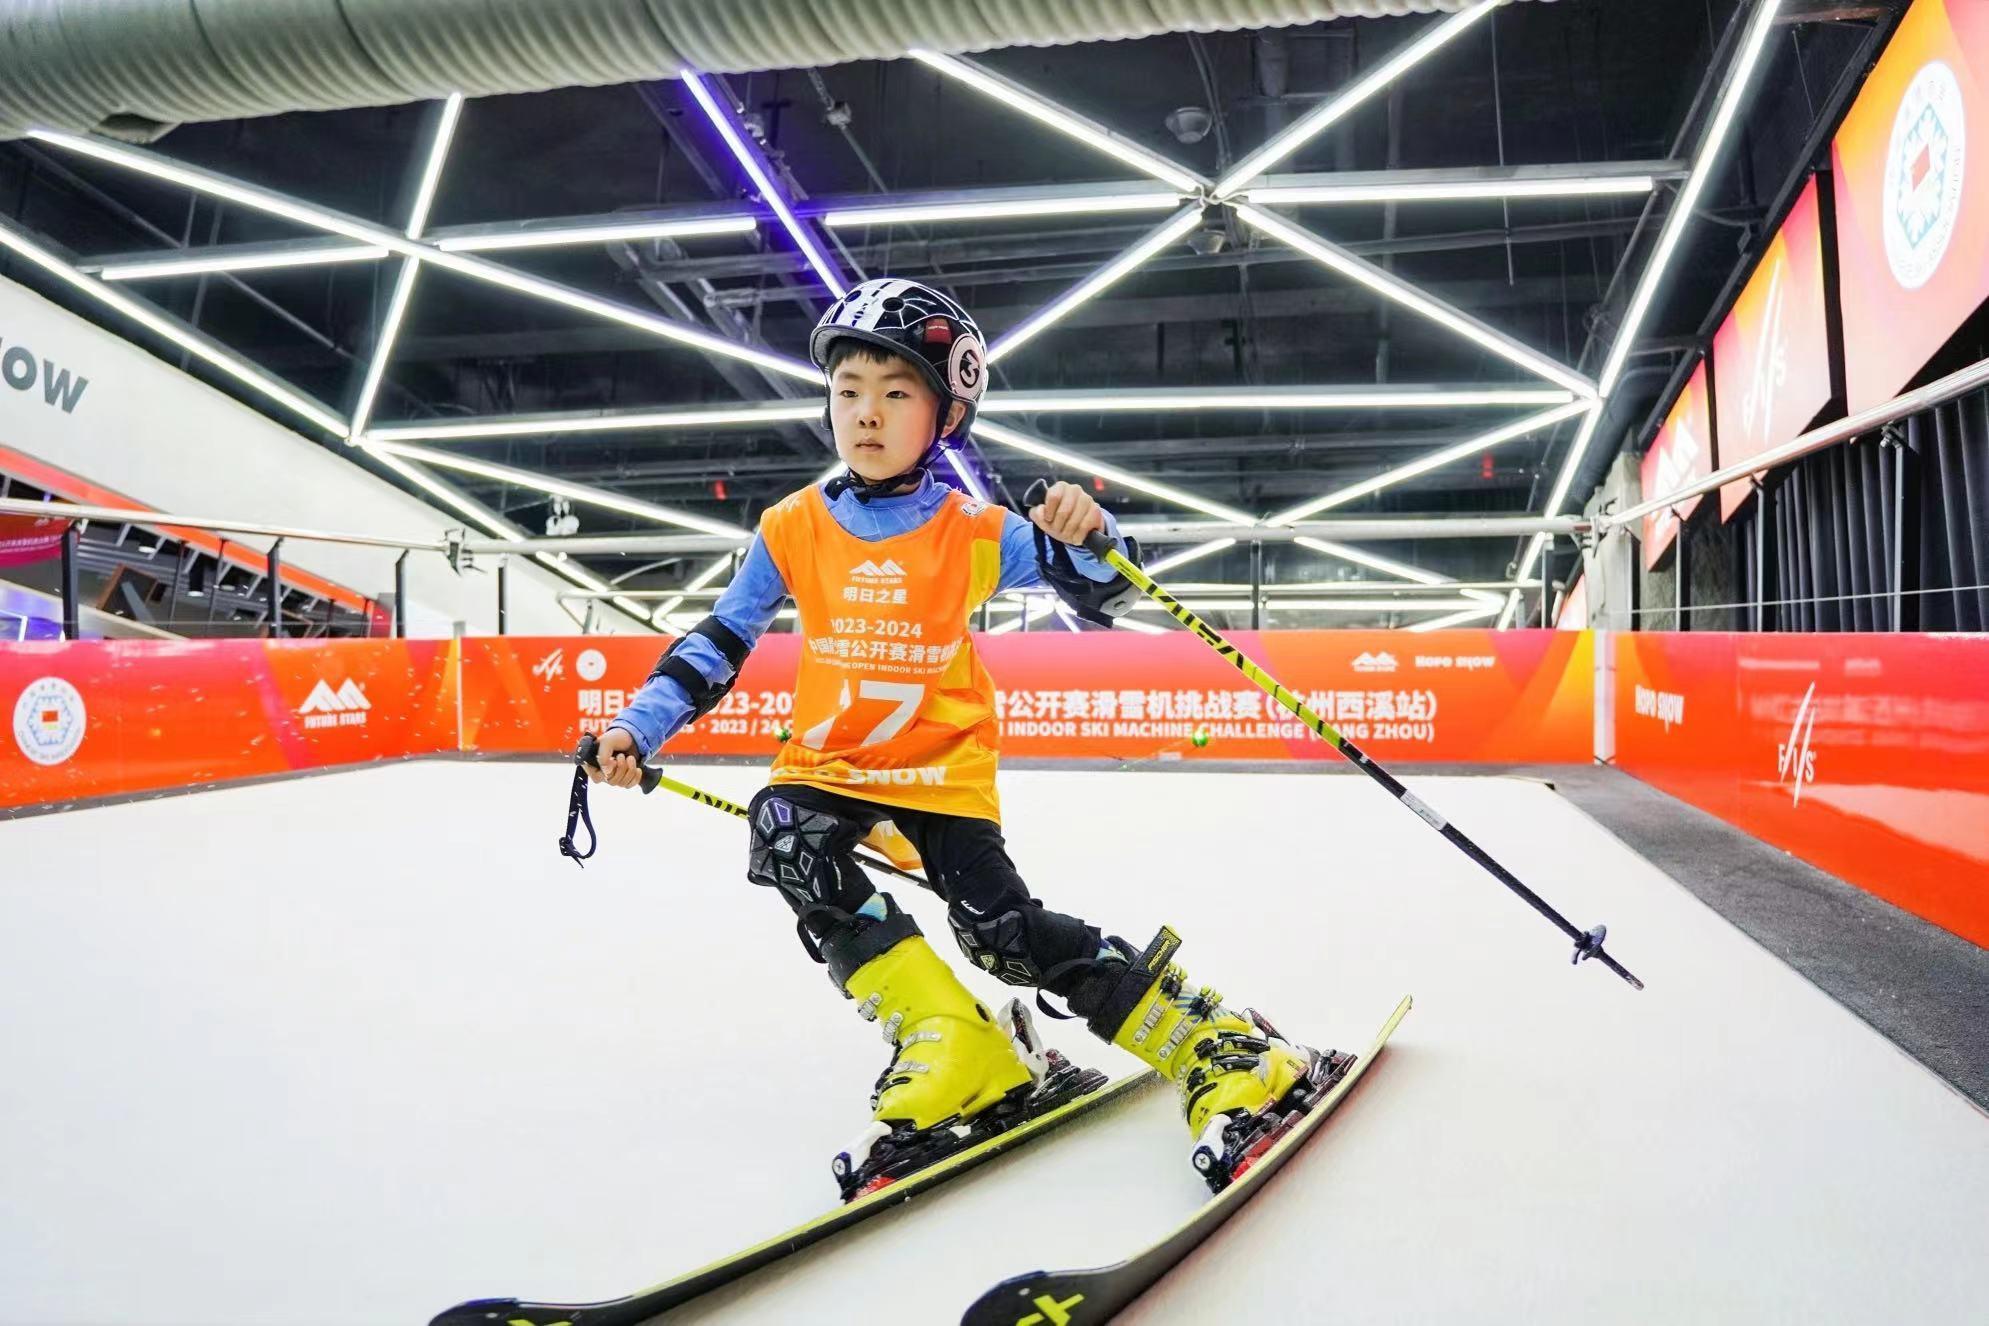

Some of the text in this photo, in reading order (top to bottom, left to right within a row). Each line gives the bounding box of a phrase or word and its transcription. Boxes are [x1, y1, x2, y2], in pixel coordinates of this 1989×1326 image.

[0, 338, 89, 414] OW
[843, 587, 907, 604] 明日之星
[878, 664, 911, 674] INDOOR
[710, 719, 747, 734] 2023
[1008, 721, 1075, 737] INDOOR
[1081, 722, 1109, 737] SKI
[1113, 722, 1192, 738] MACHINE
[1198, 723, 1305, 738] CHALLENGE
[1308, 723, 1368, 741] (ANG
[1373, 723, 1434, 742] ZHOU)
[847, 767, 946, 786] SNOW
